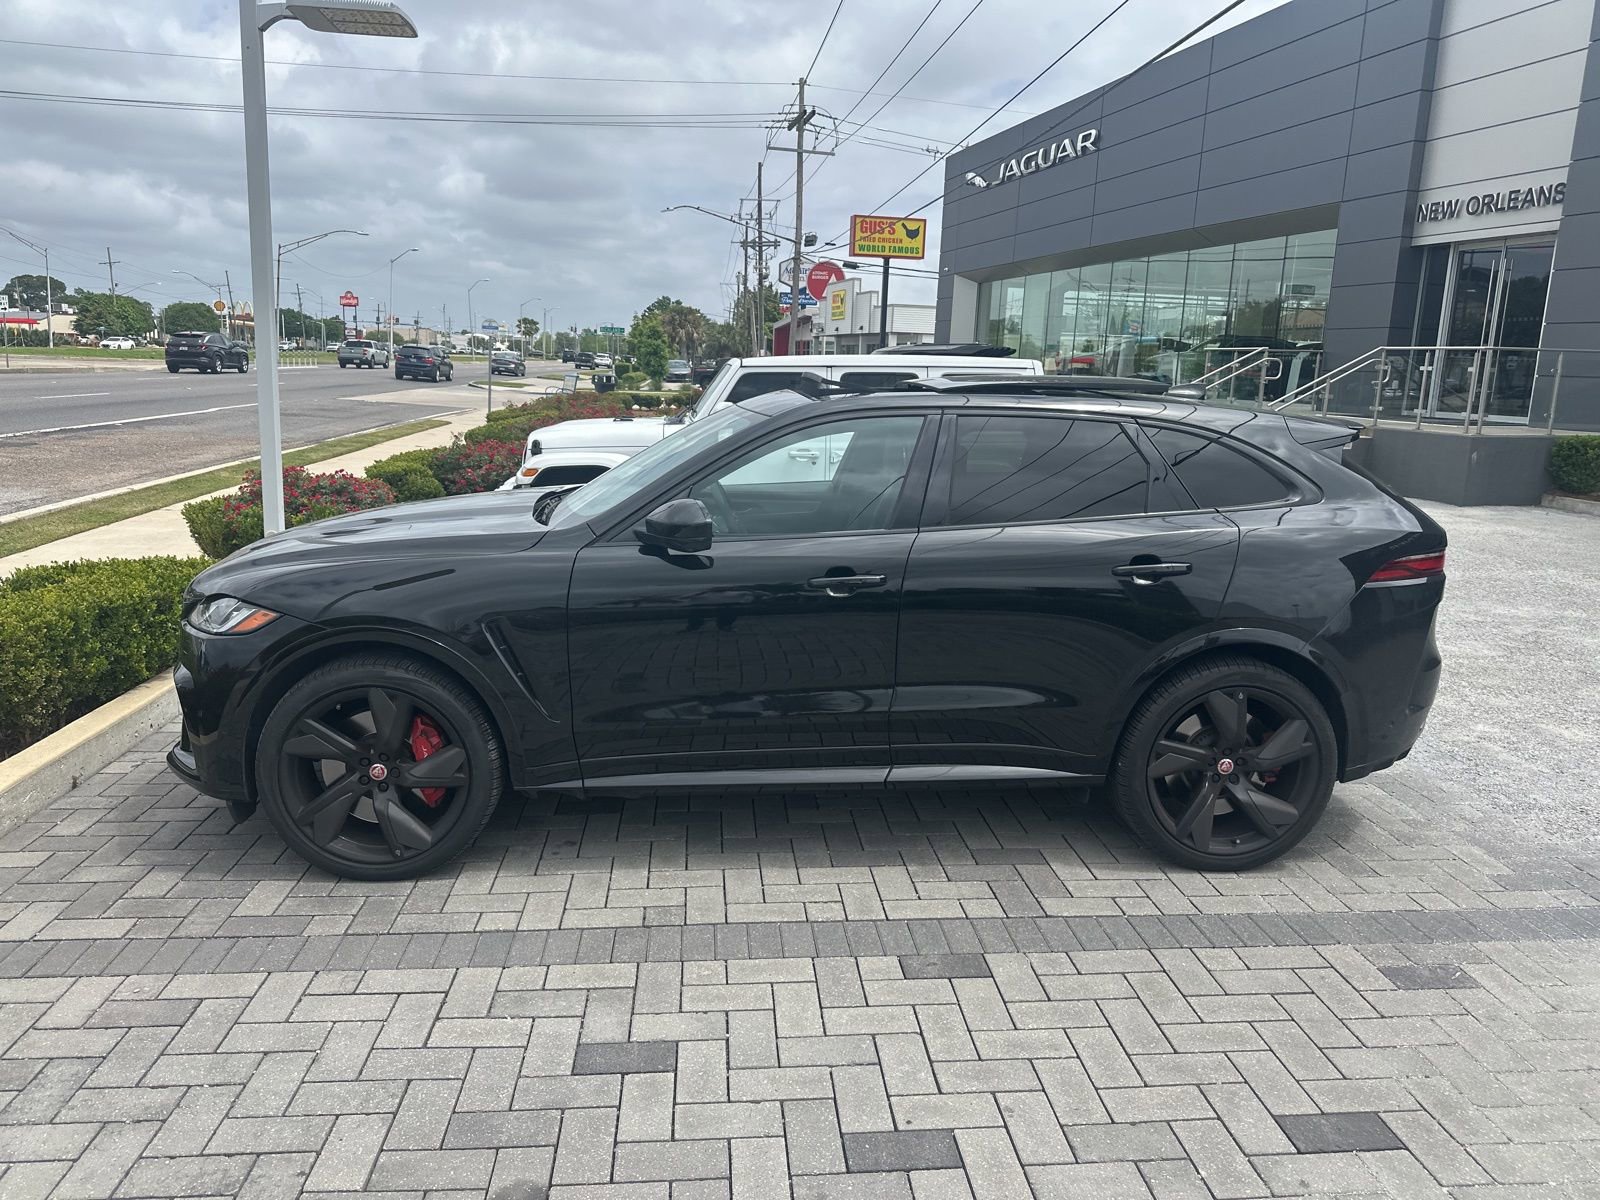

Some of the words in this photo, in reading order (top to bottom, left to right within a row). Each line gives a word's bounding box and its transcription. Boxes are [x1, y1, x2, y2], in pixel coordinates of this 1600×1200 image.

[991, 129, 1099, 185] JAGUAR
[1416, 198, 1460, 223] NEW
[1466, 182, 1567, 215] ORLEANS
[860, 219, 896, 235] GUS'S
[878, 236, 903, 244] CHICKEN
[858, 243, 886, 253] WORLD
[888, 245, 920, 255] FAMOUS
